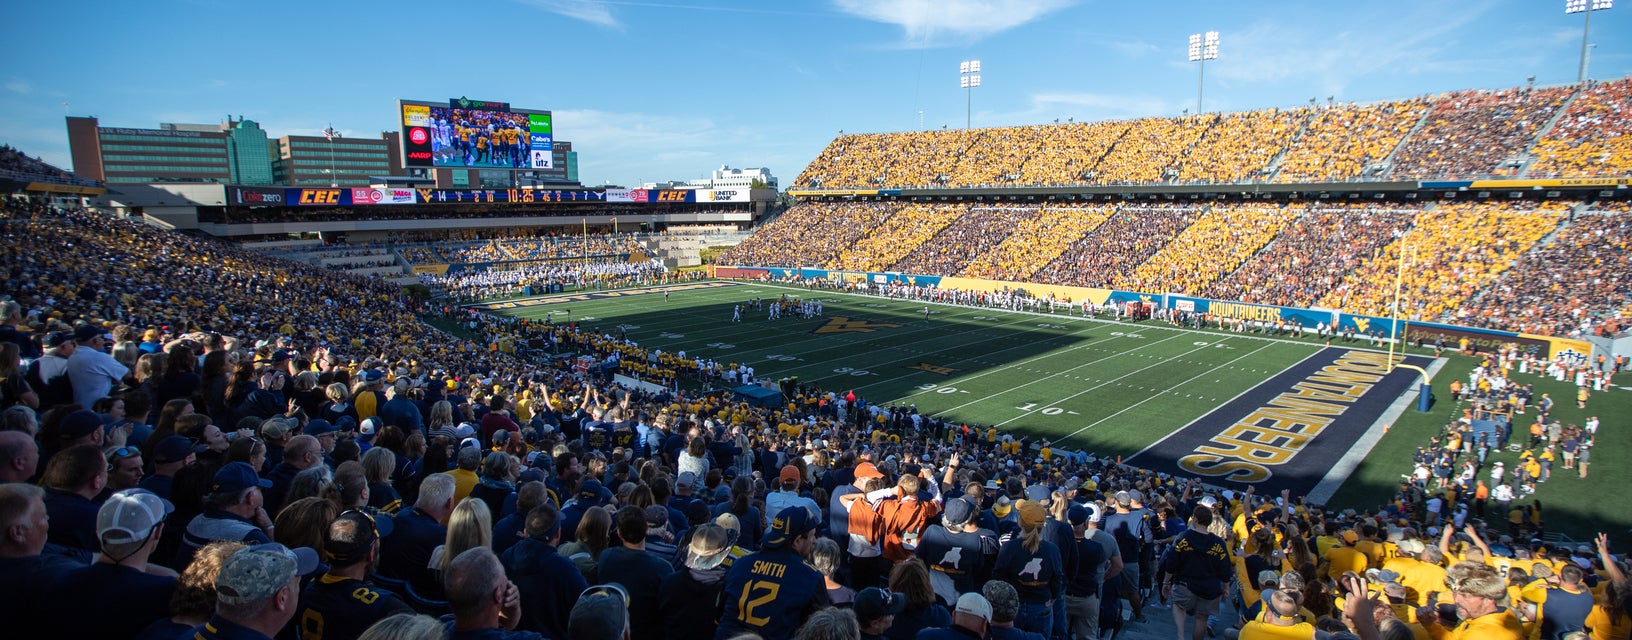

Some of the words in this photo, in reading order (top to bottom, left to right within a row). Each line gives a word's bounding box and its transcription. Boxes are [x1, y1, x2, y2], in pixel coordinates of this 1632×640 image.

[299, 189, 341, 204] CEC
[437, 190, 447, 202] 14
[474, 193, 480, 203] 2
[507, 188, 535, 203] 10:25
[542, 193, 551, 202] 45
[657, 191, 688, 201] CEC
[1208, 301, 1282, 321] MOUNTAINEERS
[1408, 329, 1458, 345] Advace
[1015, 402, 1064, 416] 10
[751, 560, 787, 578] SMITH
[352, 587, 380, 605] 8
[737, 579, 781, 627] 12
